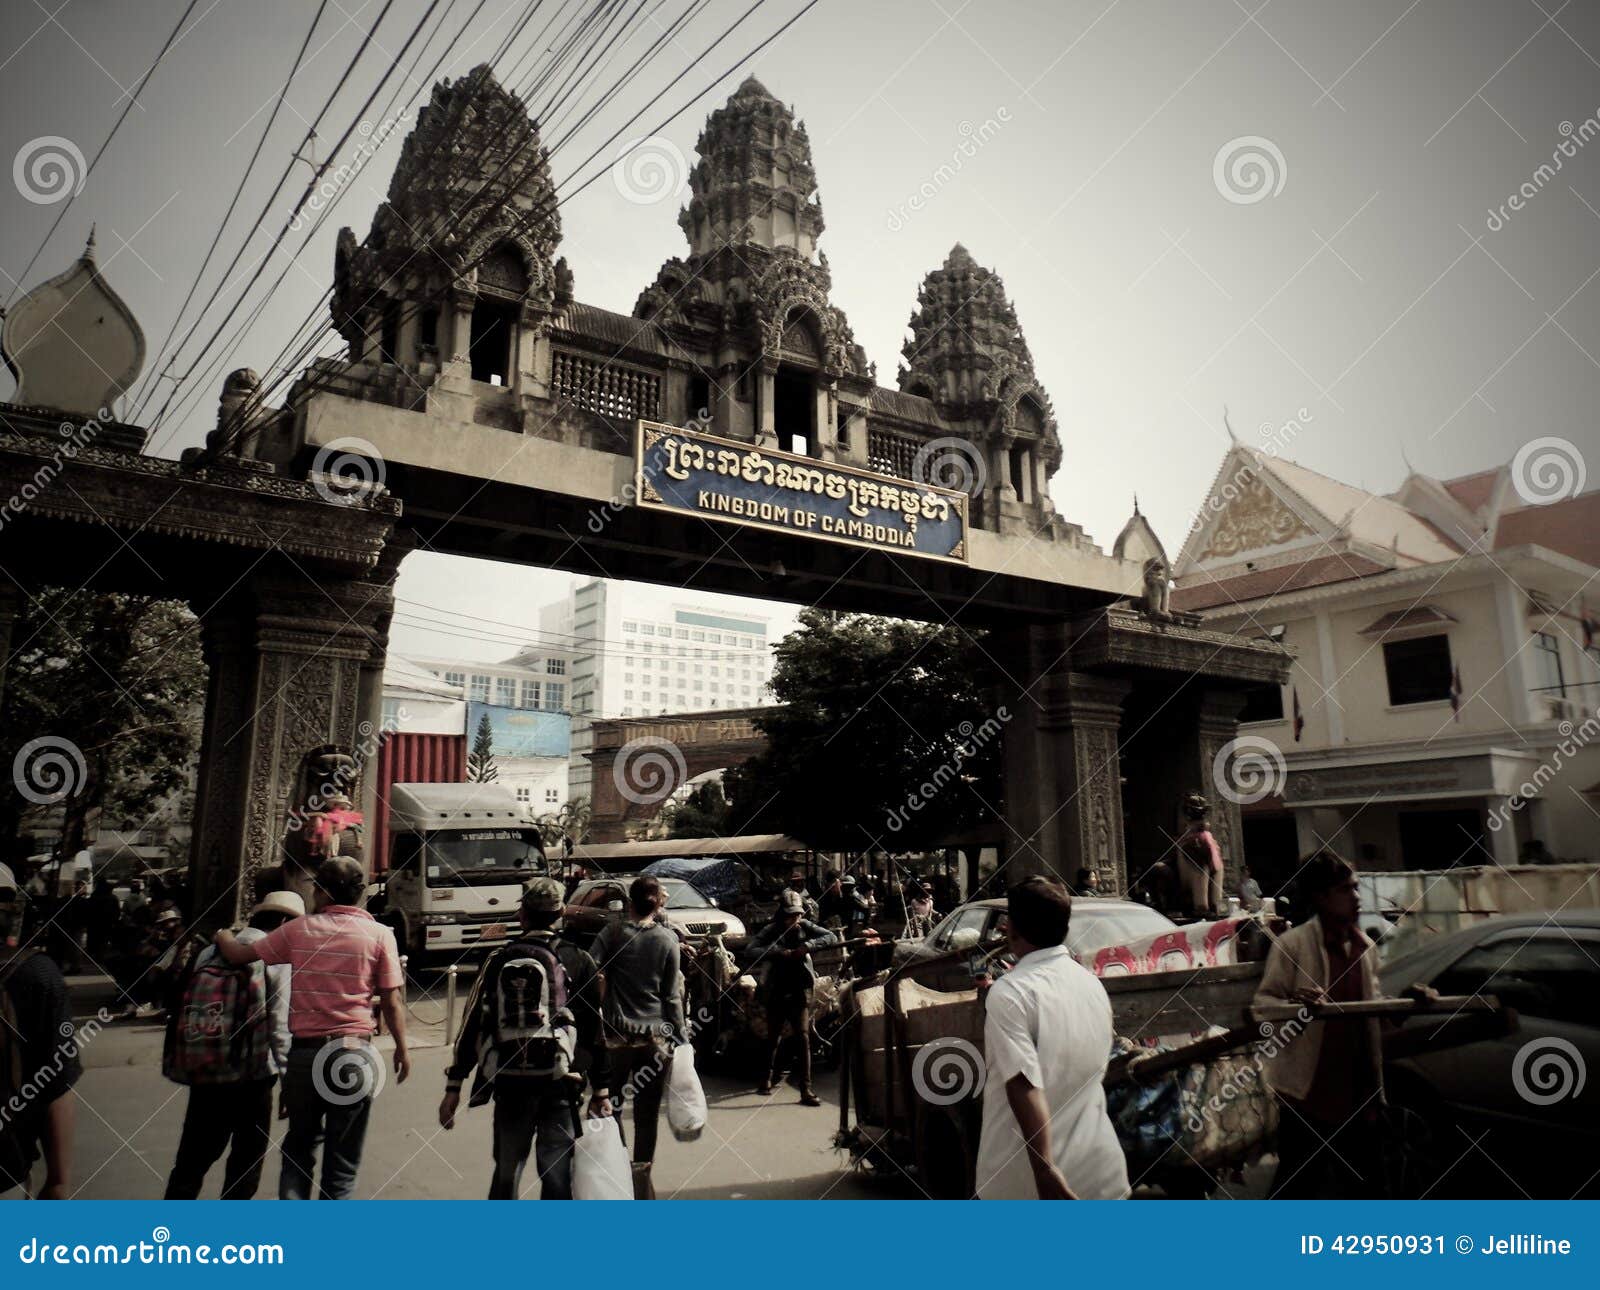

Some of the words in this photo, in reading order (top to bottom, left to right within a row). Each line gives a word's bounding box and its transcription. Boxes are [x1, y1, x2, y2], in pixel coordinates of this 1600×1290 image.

[699, 490, 788, 523] KINGDOM
[793, 510, 817, 528] OF
[821, 515, 916, 547] CAMBODIA
[624, 721, 700, 744] HOLIDAY
